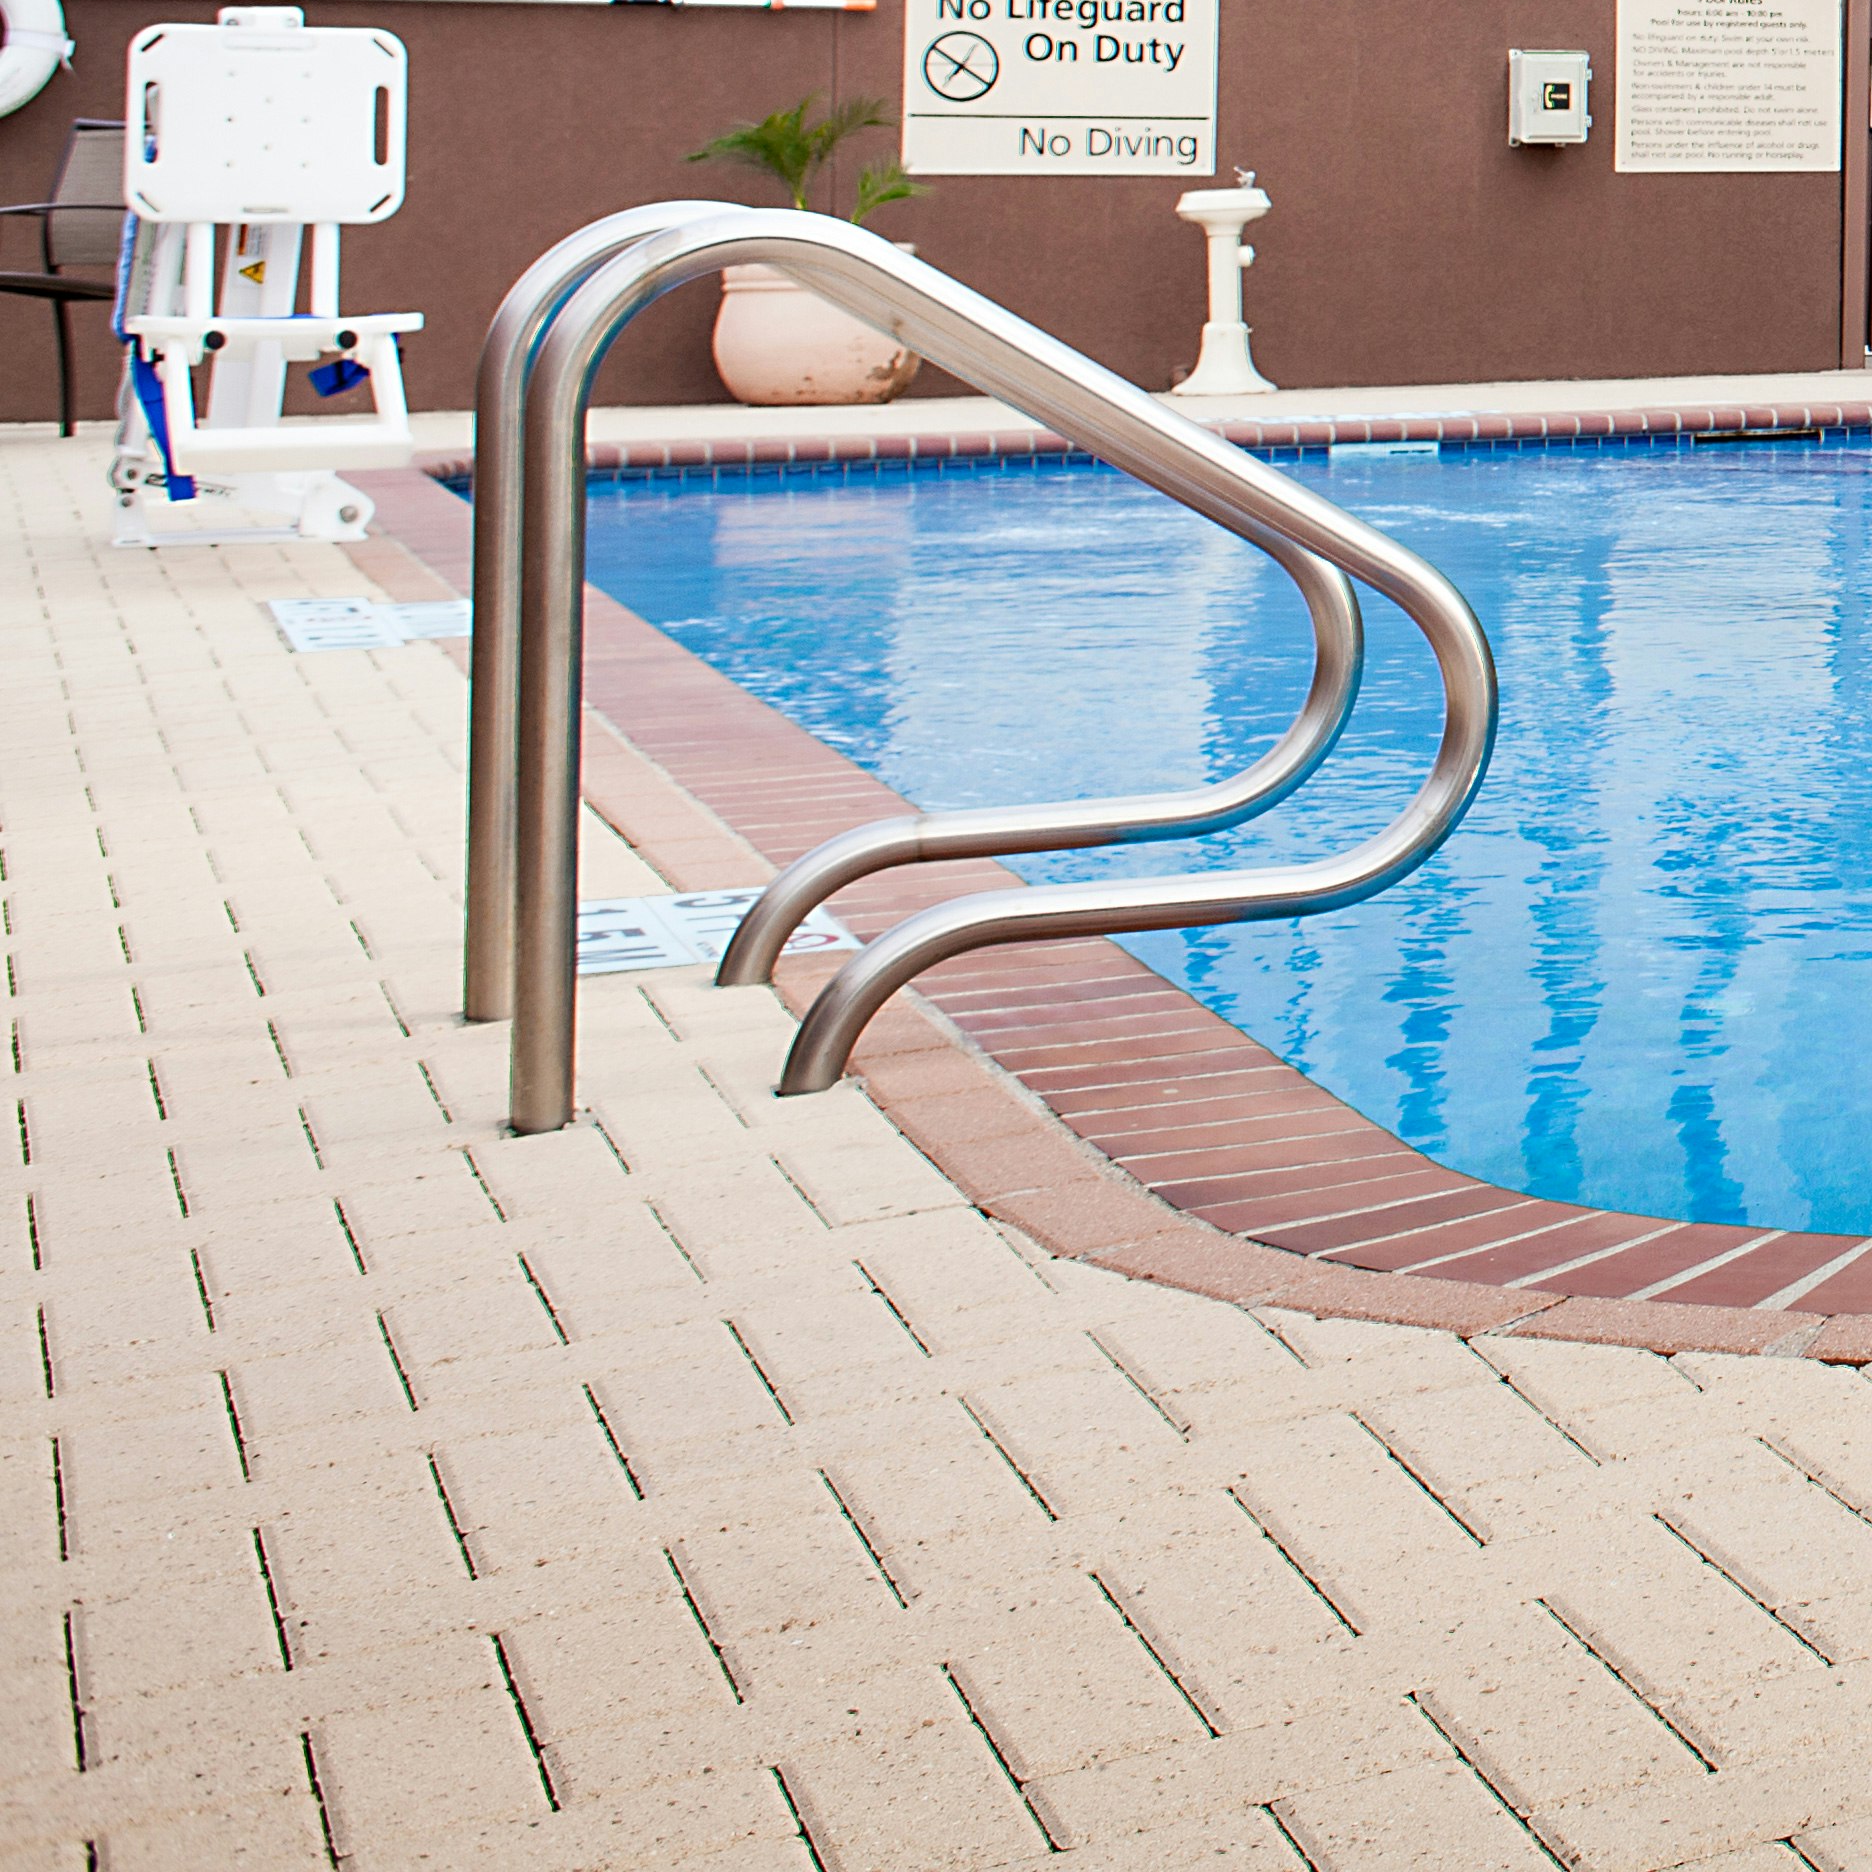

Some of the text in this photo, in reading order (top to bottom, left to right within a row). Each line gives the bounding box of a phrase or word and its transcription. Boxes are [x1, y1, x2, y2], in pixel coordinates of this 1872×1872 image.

[1023, 32, 1184, 72] On Duty
[1019, 127, 1197, 165] No Diving
